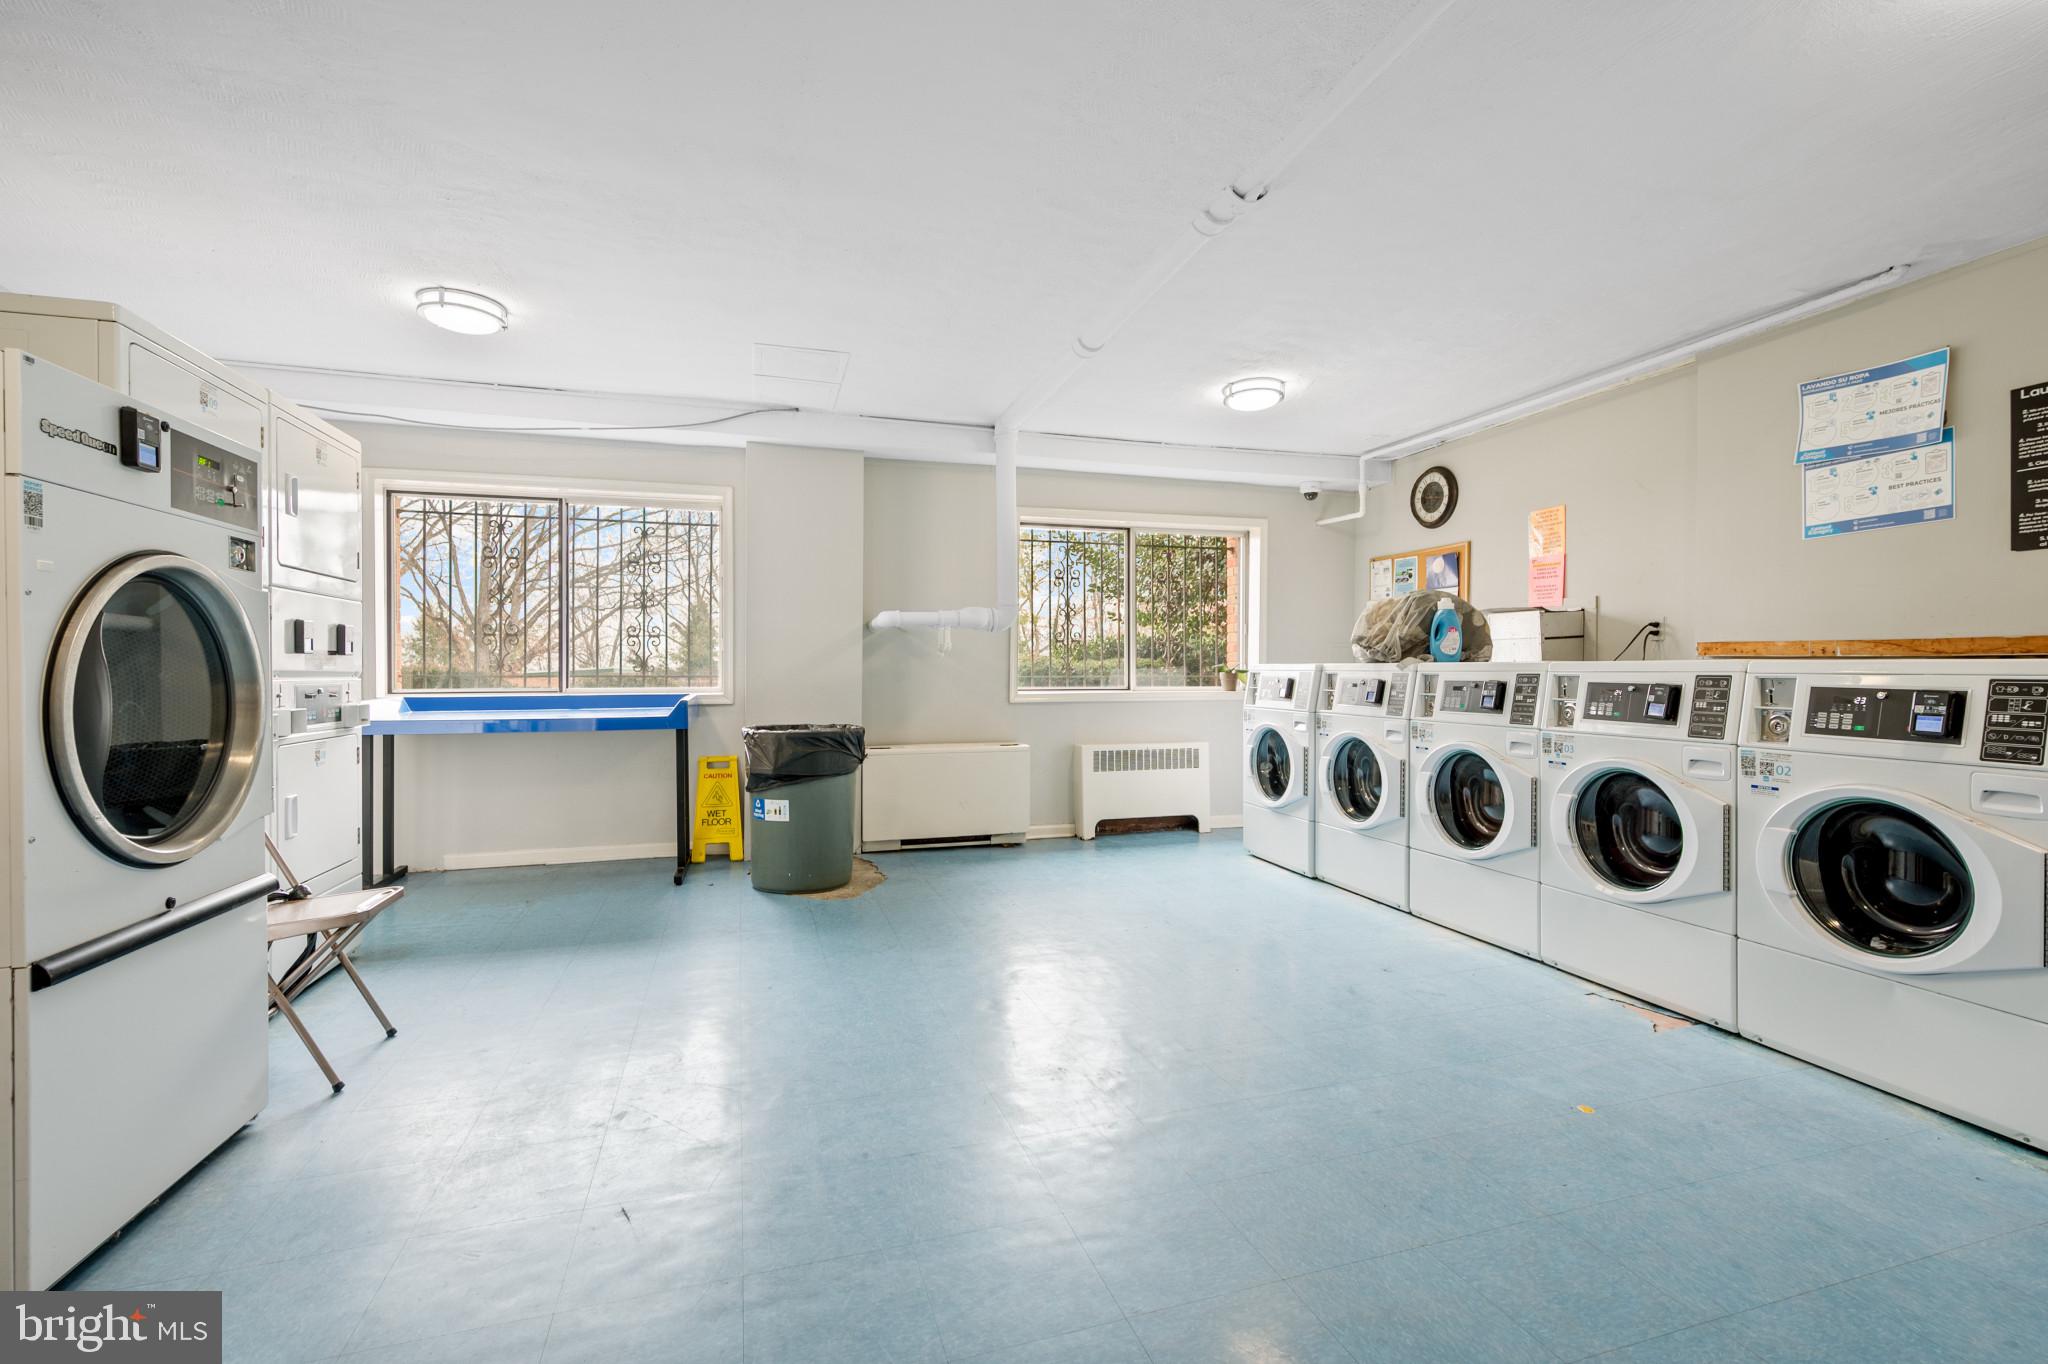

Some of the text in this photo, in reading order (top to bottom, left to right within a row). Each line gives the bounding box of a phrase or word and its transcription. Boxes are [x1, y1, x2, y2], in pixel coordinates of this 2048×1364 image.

[1802, 372, 1871, 391] LAVANDO SU ROPA
[1879, 406, 1908, 416] MEJORES
[40, 418, 118, 456] Speed Queen
[1888, 476, 1943, 491] BEST PRACTICES
[1775, 764, 1792, 777] 02
[706, 809, 727, 818] WET
[701, 817, 732, 827] FLOOR
